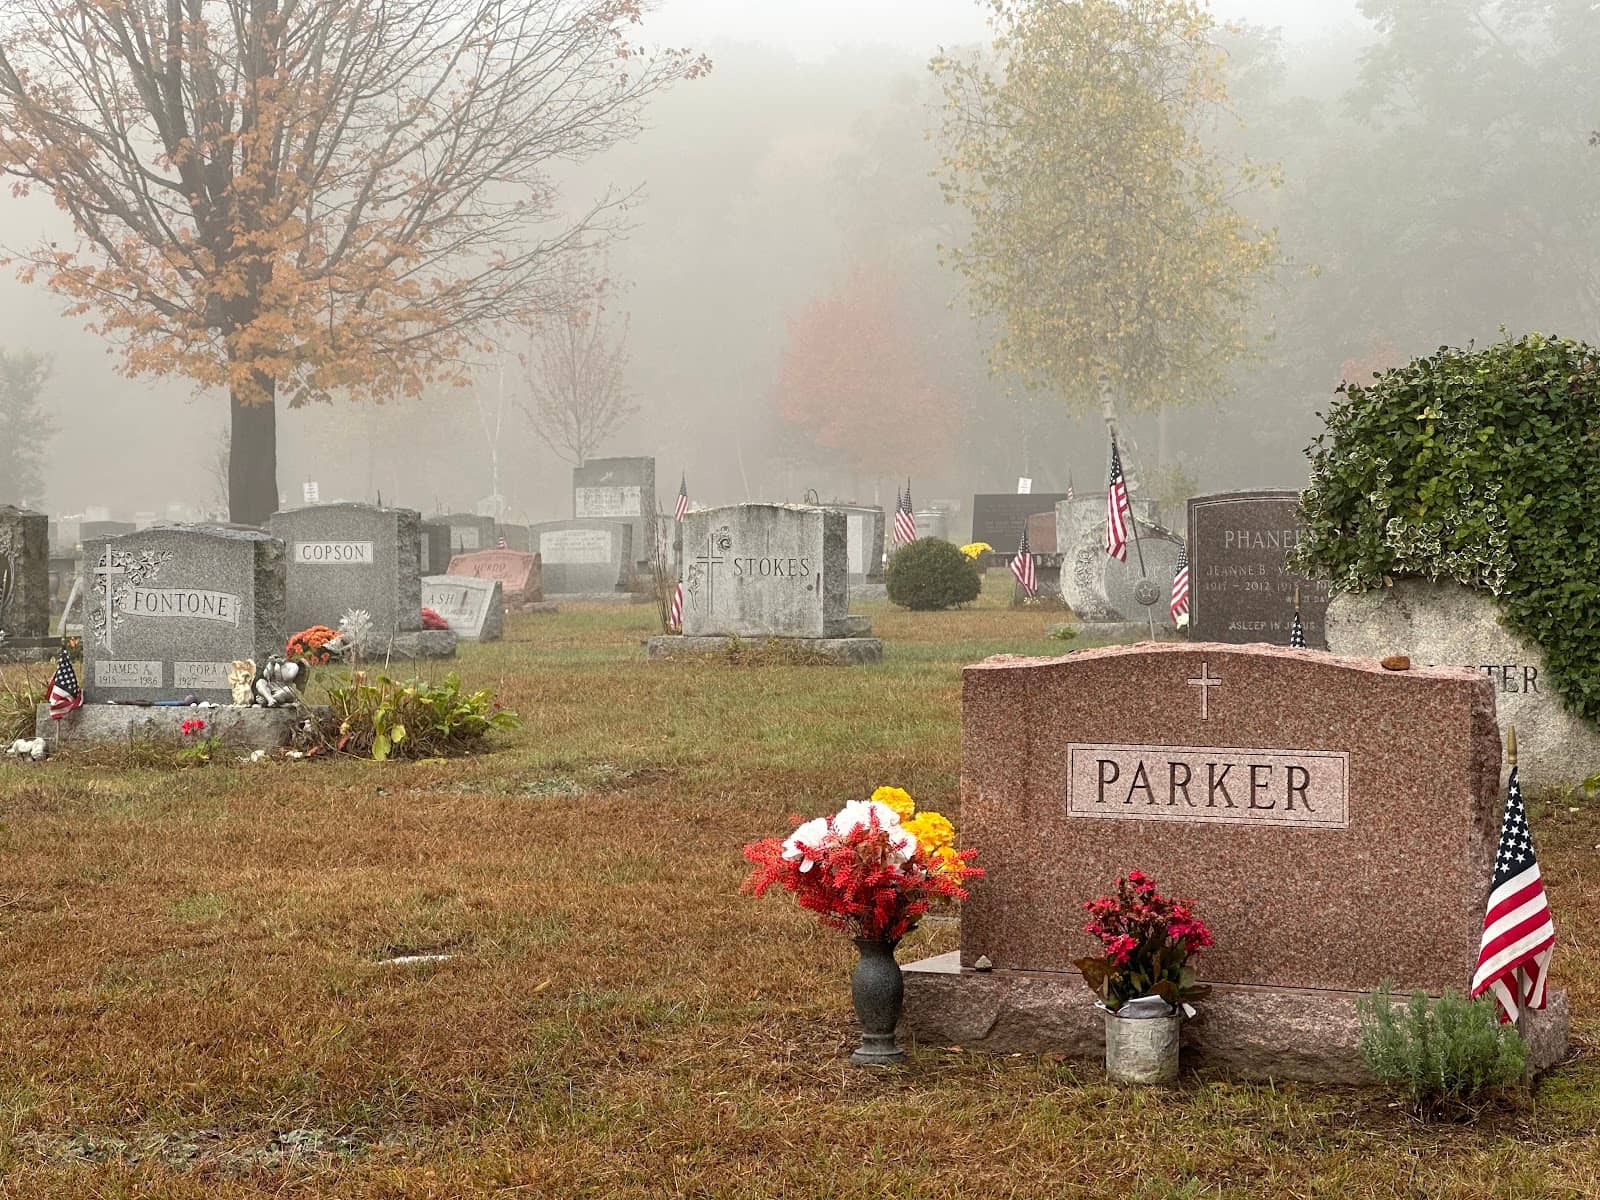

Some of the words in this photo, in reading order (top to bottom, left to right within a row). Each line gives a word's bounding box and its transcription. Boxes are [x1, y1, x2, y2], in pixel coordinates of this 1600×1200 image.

[1224, 530, 1318, 549] PHANE
[302, 545, 364, 560] COPSON
[734, 557, 810, 577] STOKES
[1206, 565, 1254, 576] JEANNE
[1244, 581, 1270, 592] 2012
[134, 592, 228, 616] FONTONE
[1229, 621, 1266, 631] ASLEEP
[1270, 621, 1280, 630] IN
[1284, 621, 1316, 631] JUS
[105, 663, 139, 674] JAMES
[189, 664, 217, 676] CORA
[179, 677, 197, 686] 1927
[1096, 759, 1316, 813] PARKER
